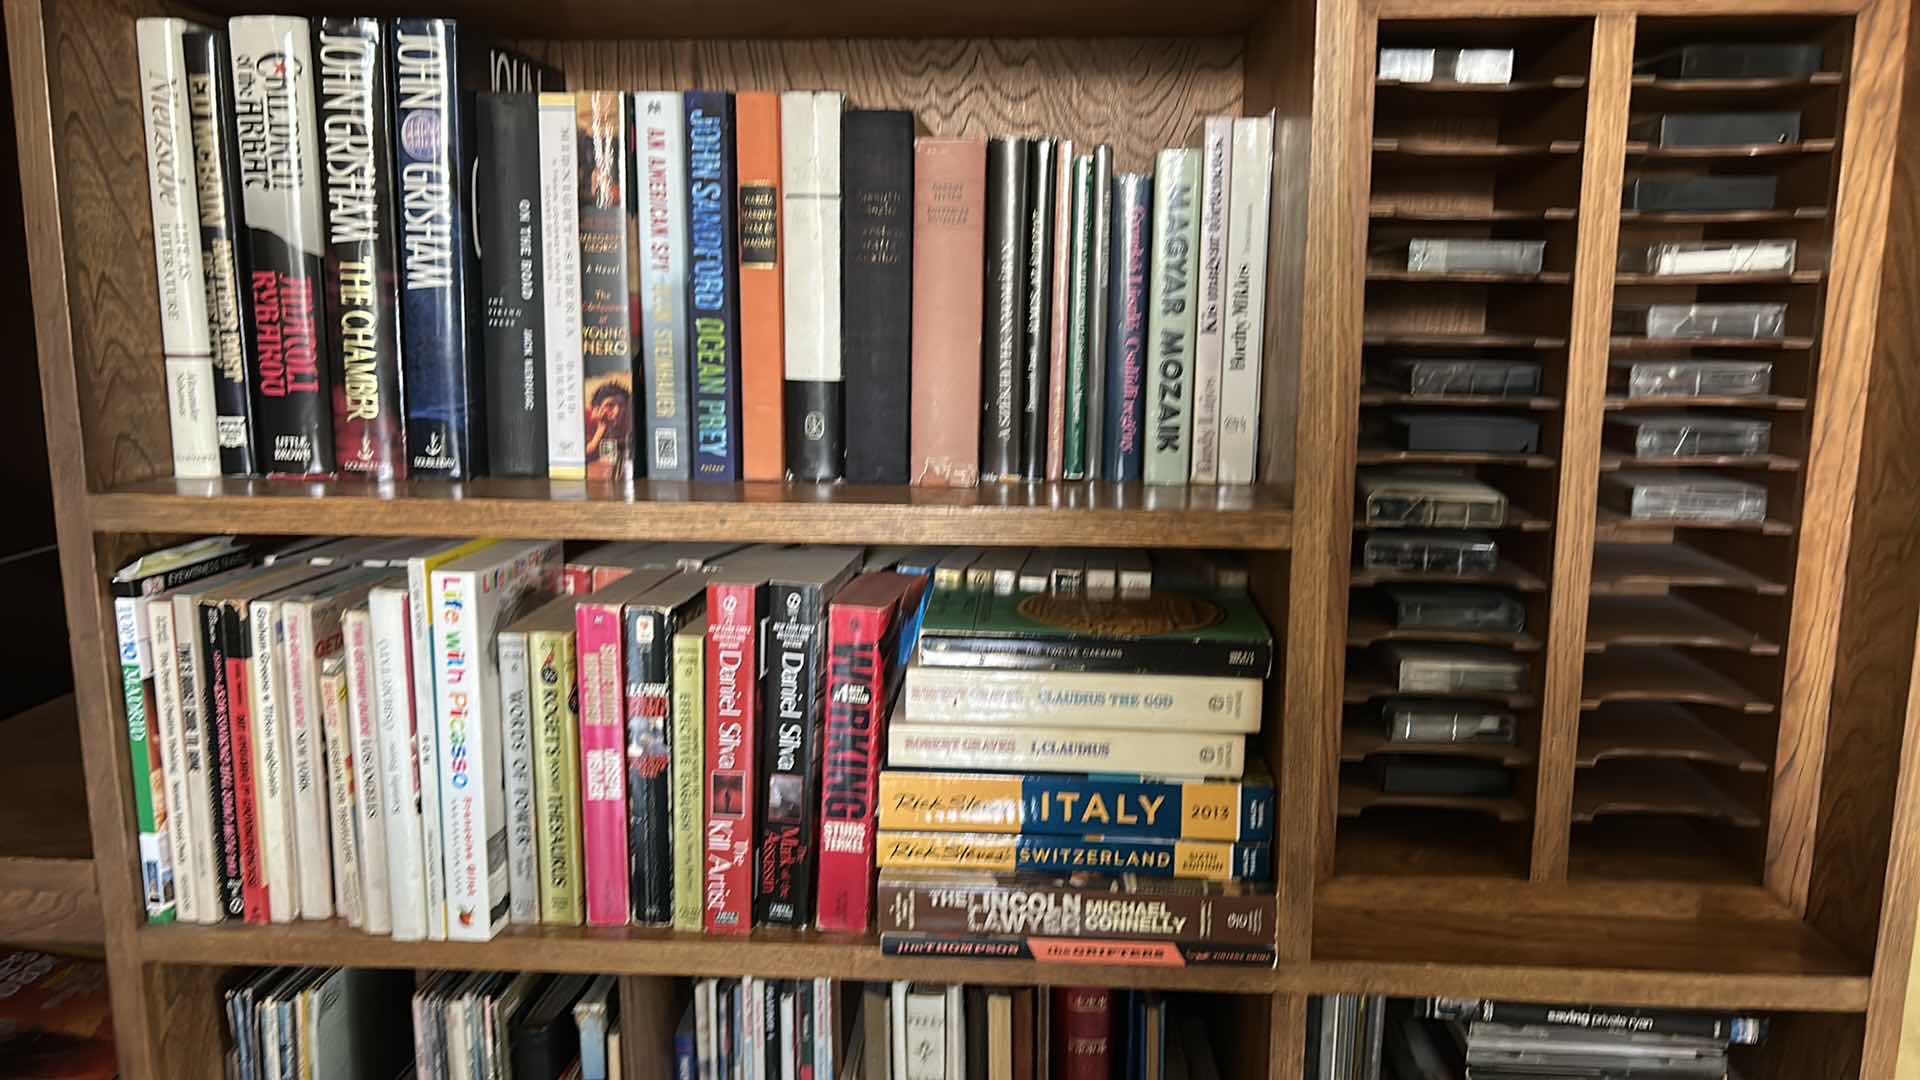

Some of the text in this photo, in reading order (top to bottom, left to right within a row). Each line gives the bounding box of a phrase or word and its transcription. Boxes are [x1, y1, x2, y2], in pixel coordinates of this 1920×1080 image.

[320, 31, 379, 244] JOHN GRISHAM
[397, 31, 453, 290] JOHN GRISHAM
[649, 155, 669, 239] AMERICAN
[690, 108, 724, 311] JOHN SANDFORD
[160, 223, 180, 320] LITERATURE
[519, 199, 534, 301] ON THE ROAD
[651, 241, 671, 273] SPY
[339, 256, 380, 422] THE CHAMBER
[1156, 183, 1193, 454] MAGYAR MOZAIK
[695, 317, 726, 394] OCEAN
[698, 399, 728, 458] PREY
[124, 665, 147, 742] MADRID
[443, 577, 470, 790] Life with Picasso
[717, 648, 743, 718] Daniel
[778, 650, 805, 718] Daniel
[1037, 689, 1106, 708] CLAUDIUS
[1108, 690, 1140, 708] THE
[1143, 692, 1174, 710] GOD
[510, 688, 531, 847] WORDS OF POWER
[717, 722, 743, 770] Silva
[777, 722, 804, 771] Silva
[823, 642, 875, 825] WORKING
[904, 735, 961, 752] ROBERT
[962, 738, 1017, 753] GRAVES
[547, 793, 568, 889] THESAURUS
[1040, 790, 1166, 826] ITALY
[1191, 803, 1231, 822] 2013
[705, 819, 733, 911] Kill Artist
[733, 840, 750, 866] The
[1019, 846, 1171, 869] SWITZERLAND
[929, 889, 1082, 915] THE LINCOLN
[967, 905, 1081, 936] LAWYER
[1083, 914, 1187, 936] CONNELLY
[1085, 898, 1171, 918] MICHAEL
[1546, 1009, 1655, 1033] saving private ryan
